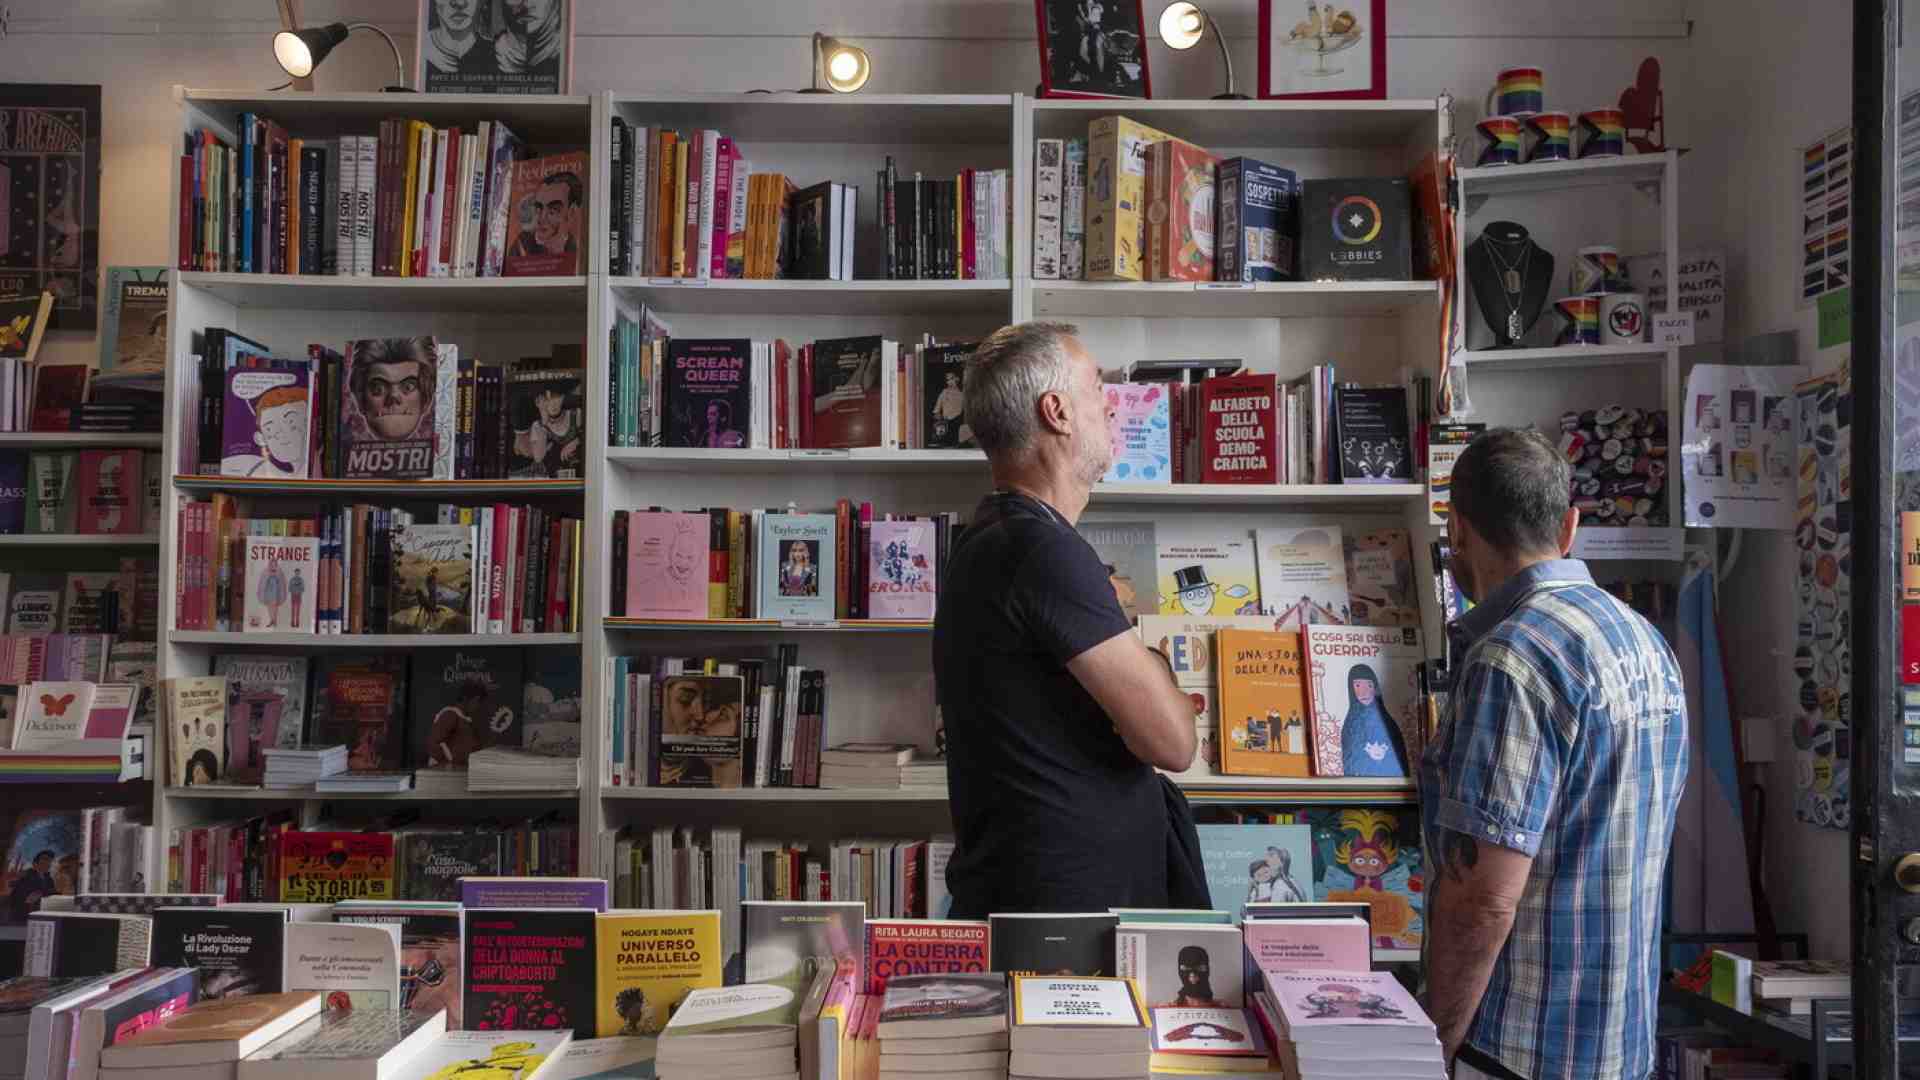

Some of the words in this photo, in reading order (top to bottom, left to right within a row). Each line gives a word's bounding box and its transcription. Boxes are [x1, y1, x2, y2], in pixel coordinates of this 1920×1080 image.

[472, 171, 484, 221] PATIENCE
[339, 192, 351, 239] MOSTRI
[357, 191, 370, 238] MOSTRI
[127, 286, 168, 297] TREMA
[676, 357, 744, 369] SCREAM
[685, 369, 740, 382] QUEER
[1209, 396, 1271, 412] ALFABETO
[1221, 411, 1259, 425] DELLA
[1215, 426, 1265, 441] SCUOLA
[1219, 442, 1261, 456] DEMO-
[347, 448, 431, 472] MOSTRI
[1213, 456, 1268, 471] CRATICA
[251, 546, 312, 561] STRANGE
[1312, 631, 1343, 642] COSA
[1345, 632, 1363, 642] SAI
[1366, 633, 1401, 645] DELLA
[1237, 650, 1262, 661] UNA
[1267, 648, 1299, 660] STOR
[1313, 643, 1380, 657] GUERRA?
[1234, 663, 1268, 674] DELLE
[306, 879, 368, 896] STORIA
[183, 934, 196, 944] La
[199, 933, 253, 944] Rivoluzione
[875, 927, 898, 937] RITA
[901, 927, 938, 937] LAURA
[940, 927, 985, 938] SEGATO
[184, 943, 195, 953] di
[198, 944, 220, 954] Lady
[222, 944, 250, 954] Oscar
[622, 939, 695, 952] UNIVERSO
[875, 943, 897, 958] LA
[903, 943, 984, 959] GUERRA
[616, 951, 701, 965] PARALLELO
[875, 959, 983, 977] CONTRO
